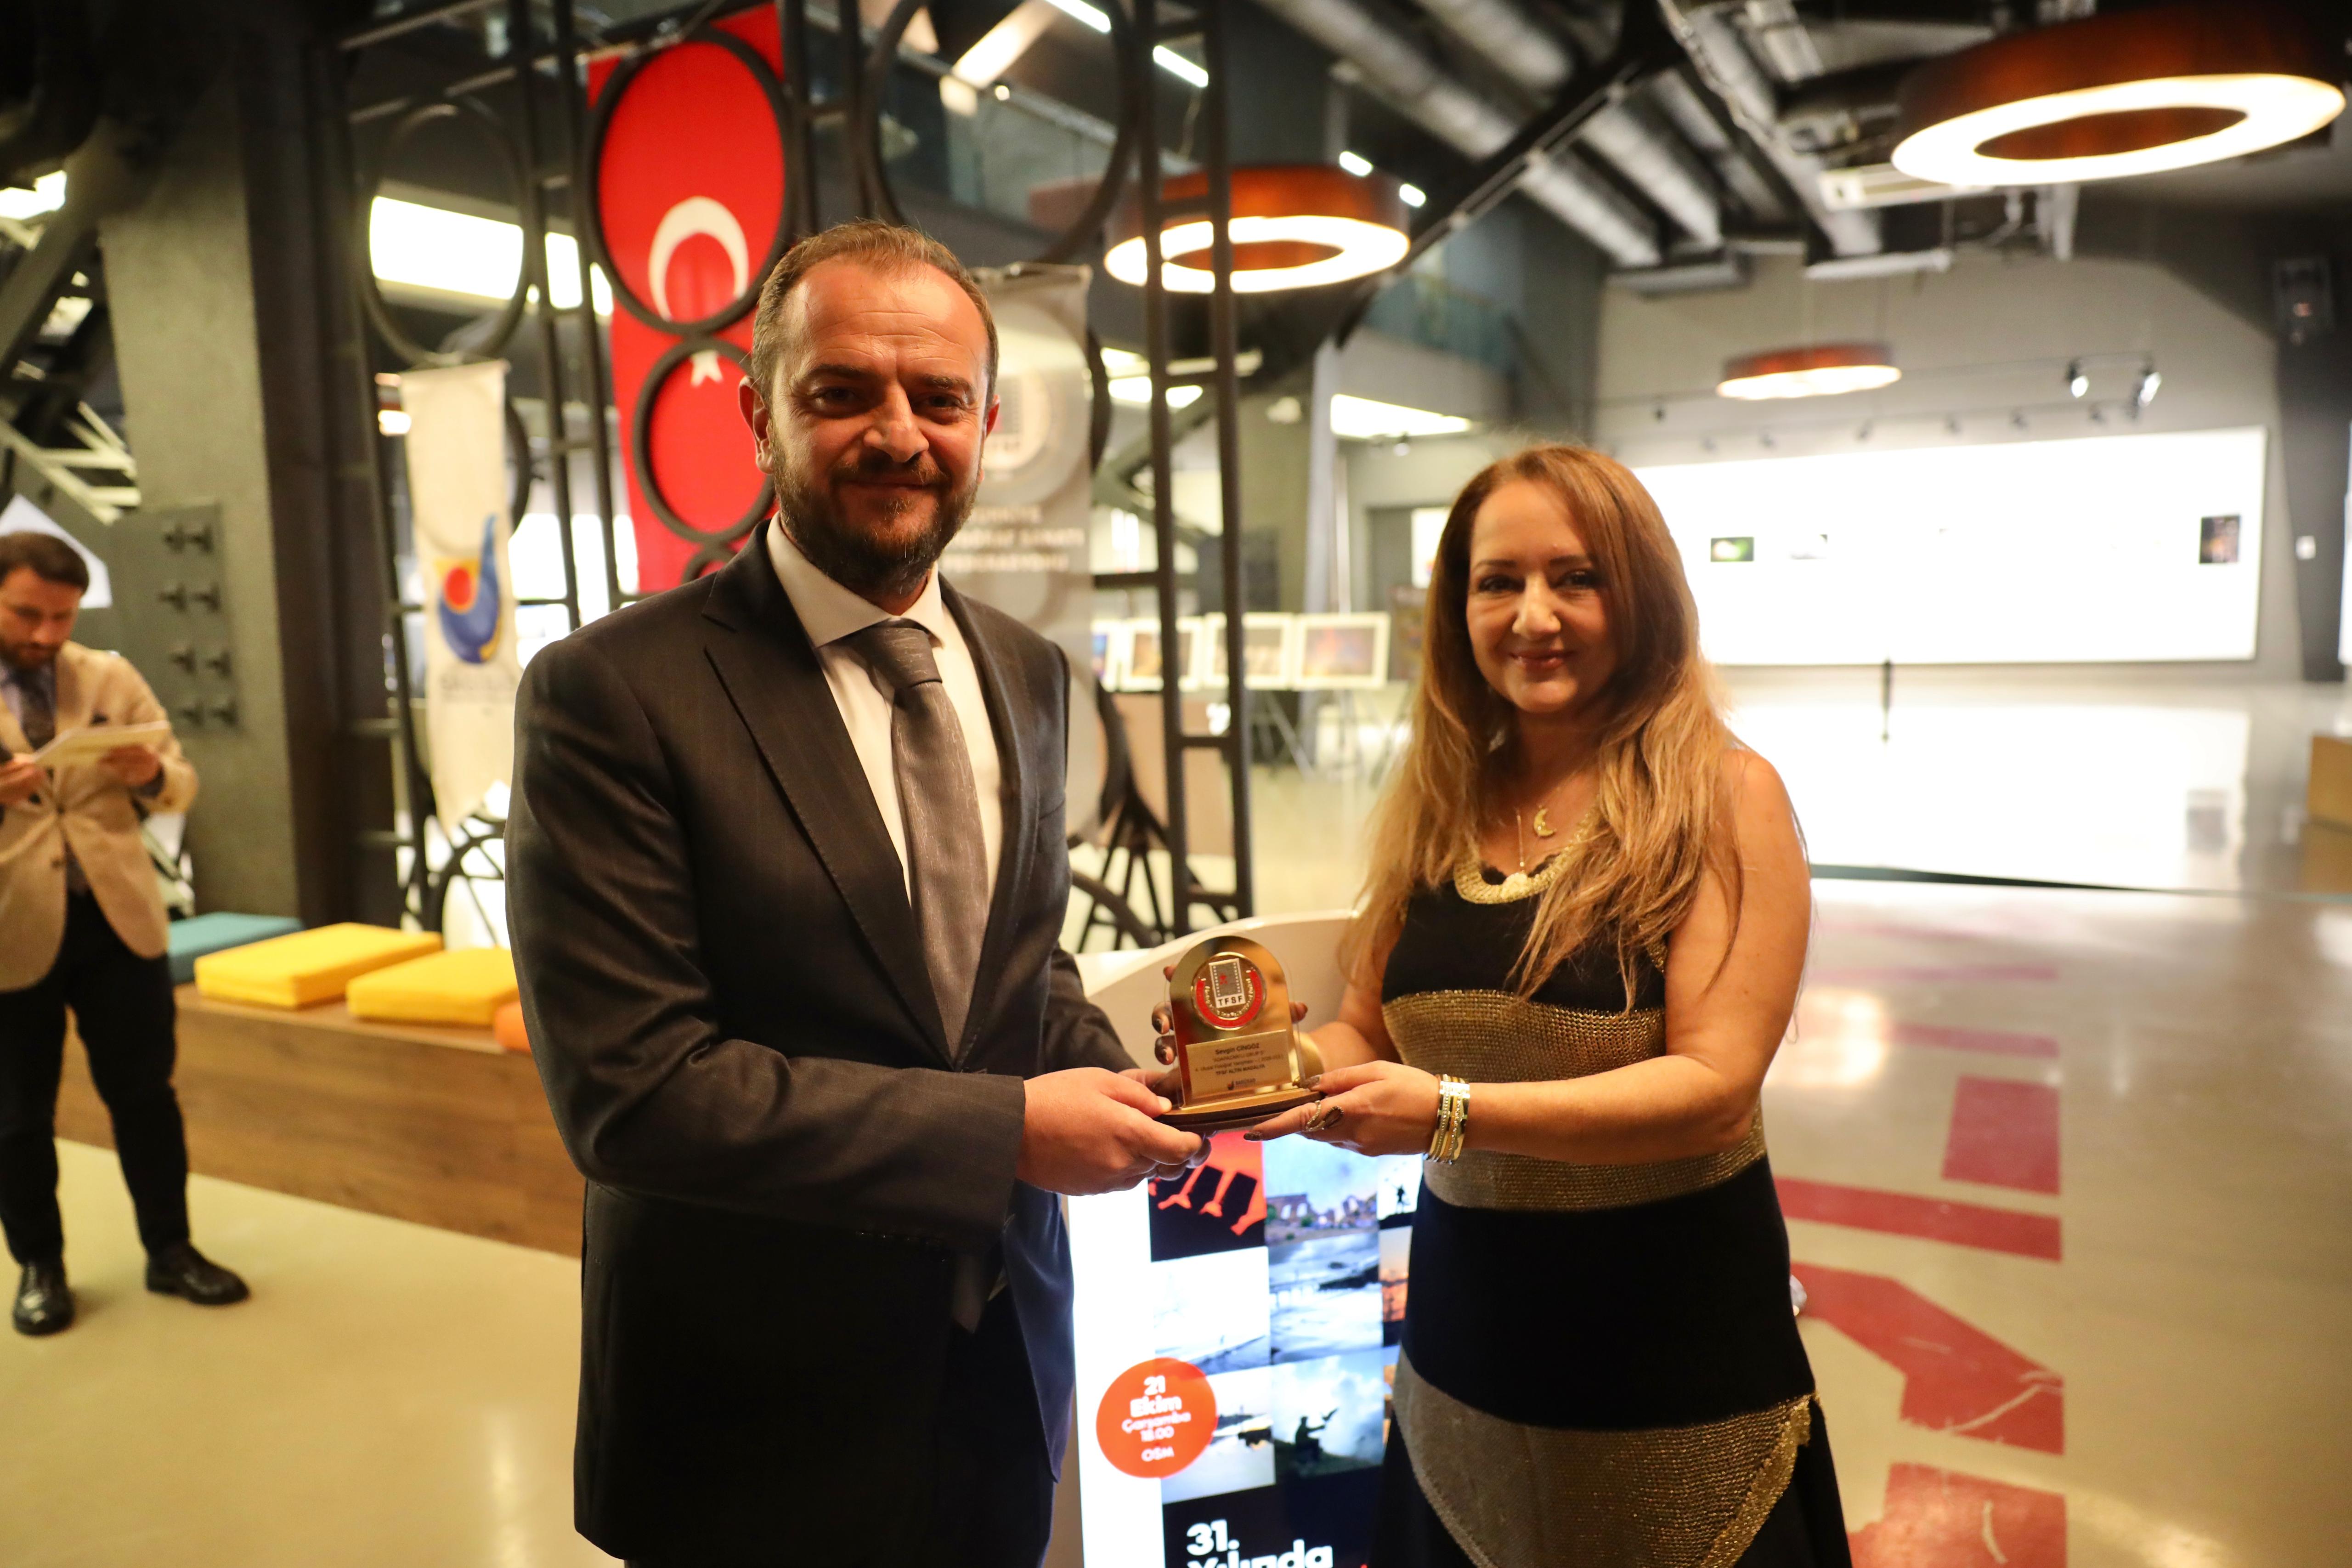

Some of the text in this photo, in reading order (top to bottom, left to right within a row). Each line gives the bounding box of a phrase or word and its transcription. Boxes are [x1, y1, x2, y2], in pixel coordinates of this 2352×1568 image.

[1218, 996, 1243, 1006] TFSF
[1143, 1375, 1166, 1396] 21
[1130, 1394, 1182, 1417] Ekim
[1141, 1446, 1175, 1462] OSM
[1187, 1519, 1240, 1556] 31.
